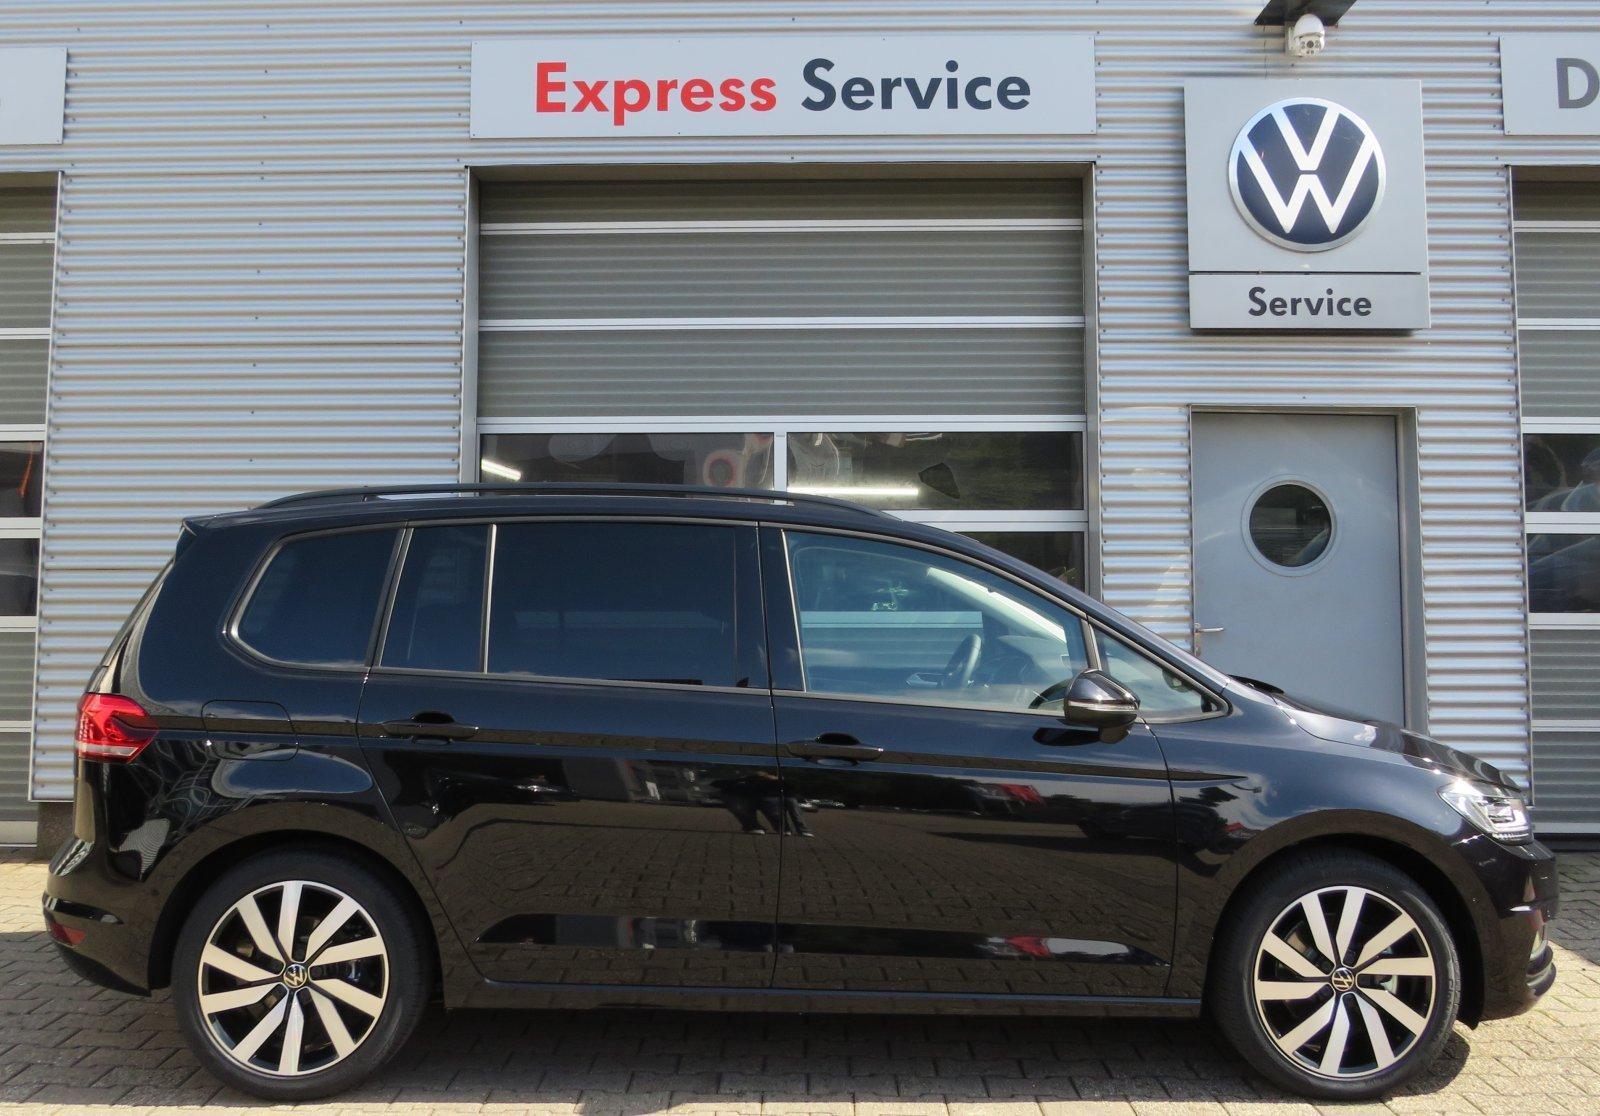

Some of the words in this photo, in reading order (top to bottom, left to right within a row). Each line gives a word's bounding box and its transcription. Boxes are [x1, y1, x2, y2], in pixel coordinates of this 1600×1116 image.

[536, 62, 777, 126] Express
[801, 58, 1031, 111] Service
[1233, 100, 1381, 240] VW
[1248, 286, 1372, 317] Service
